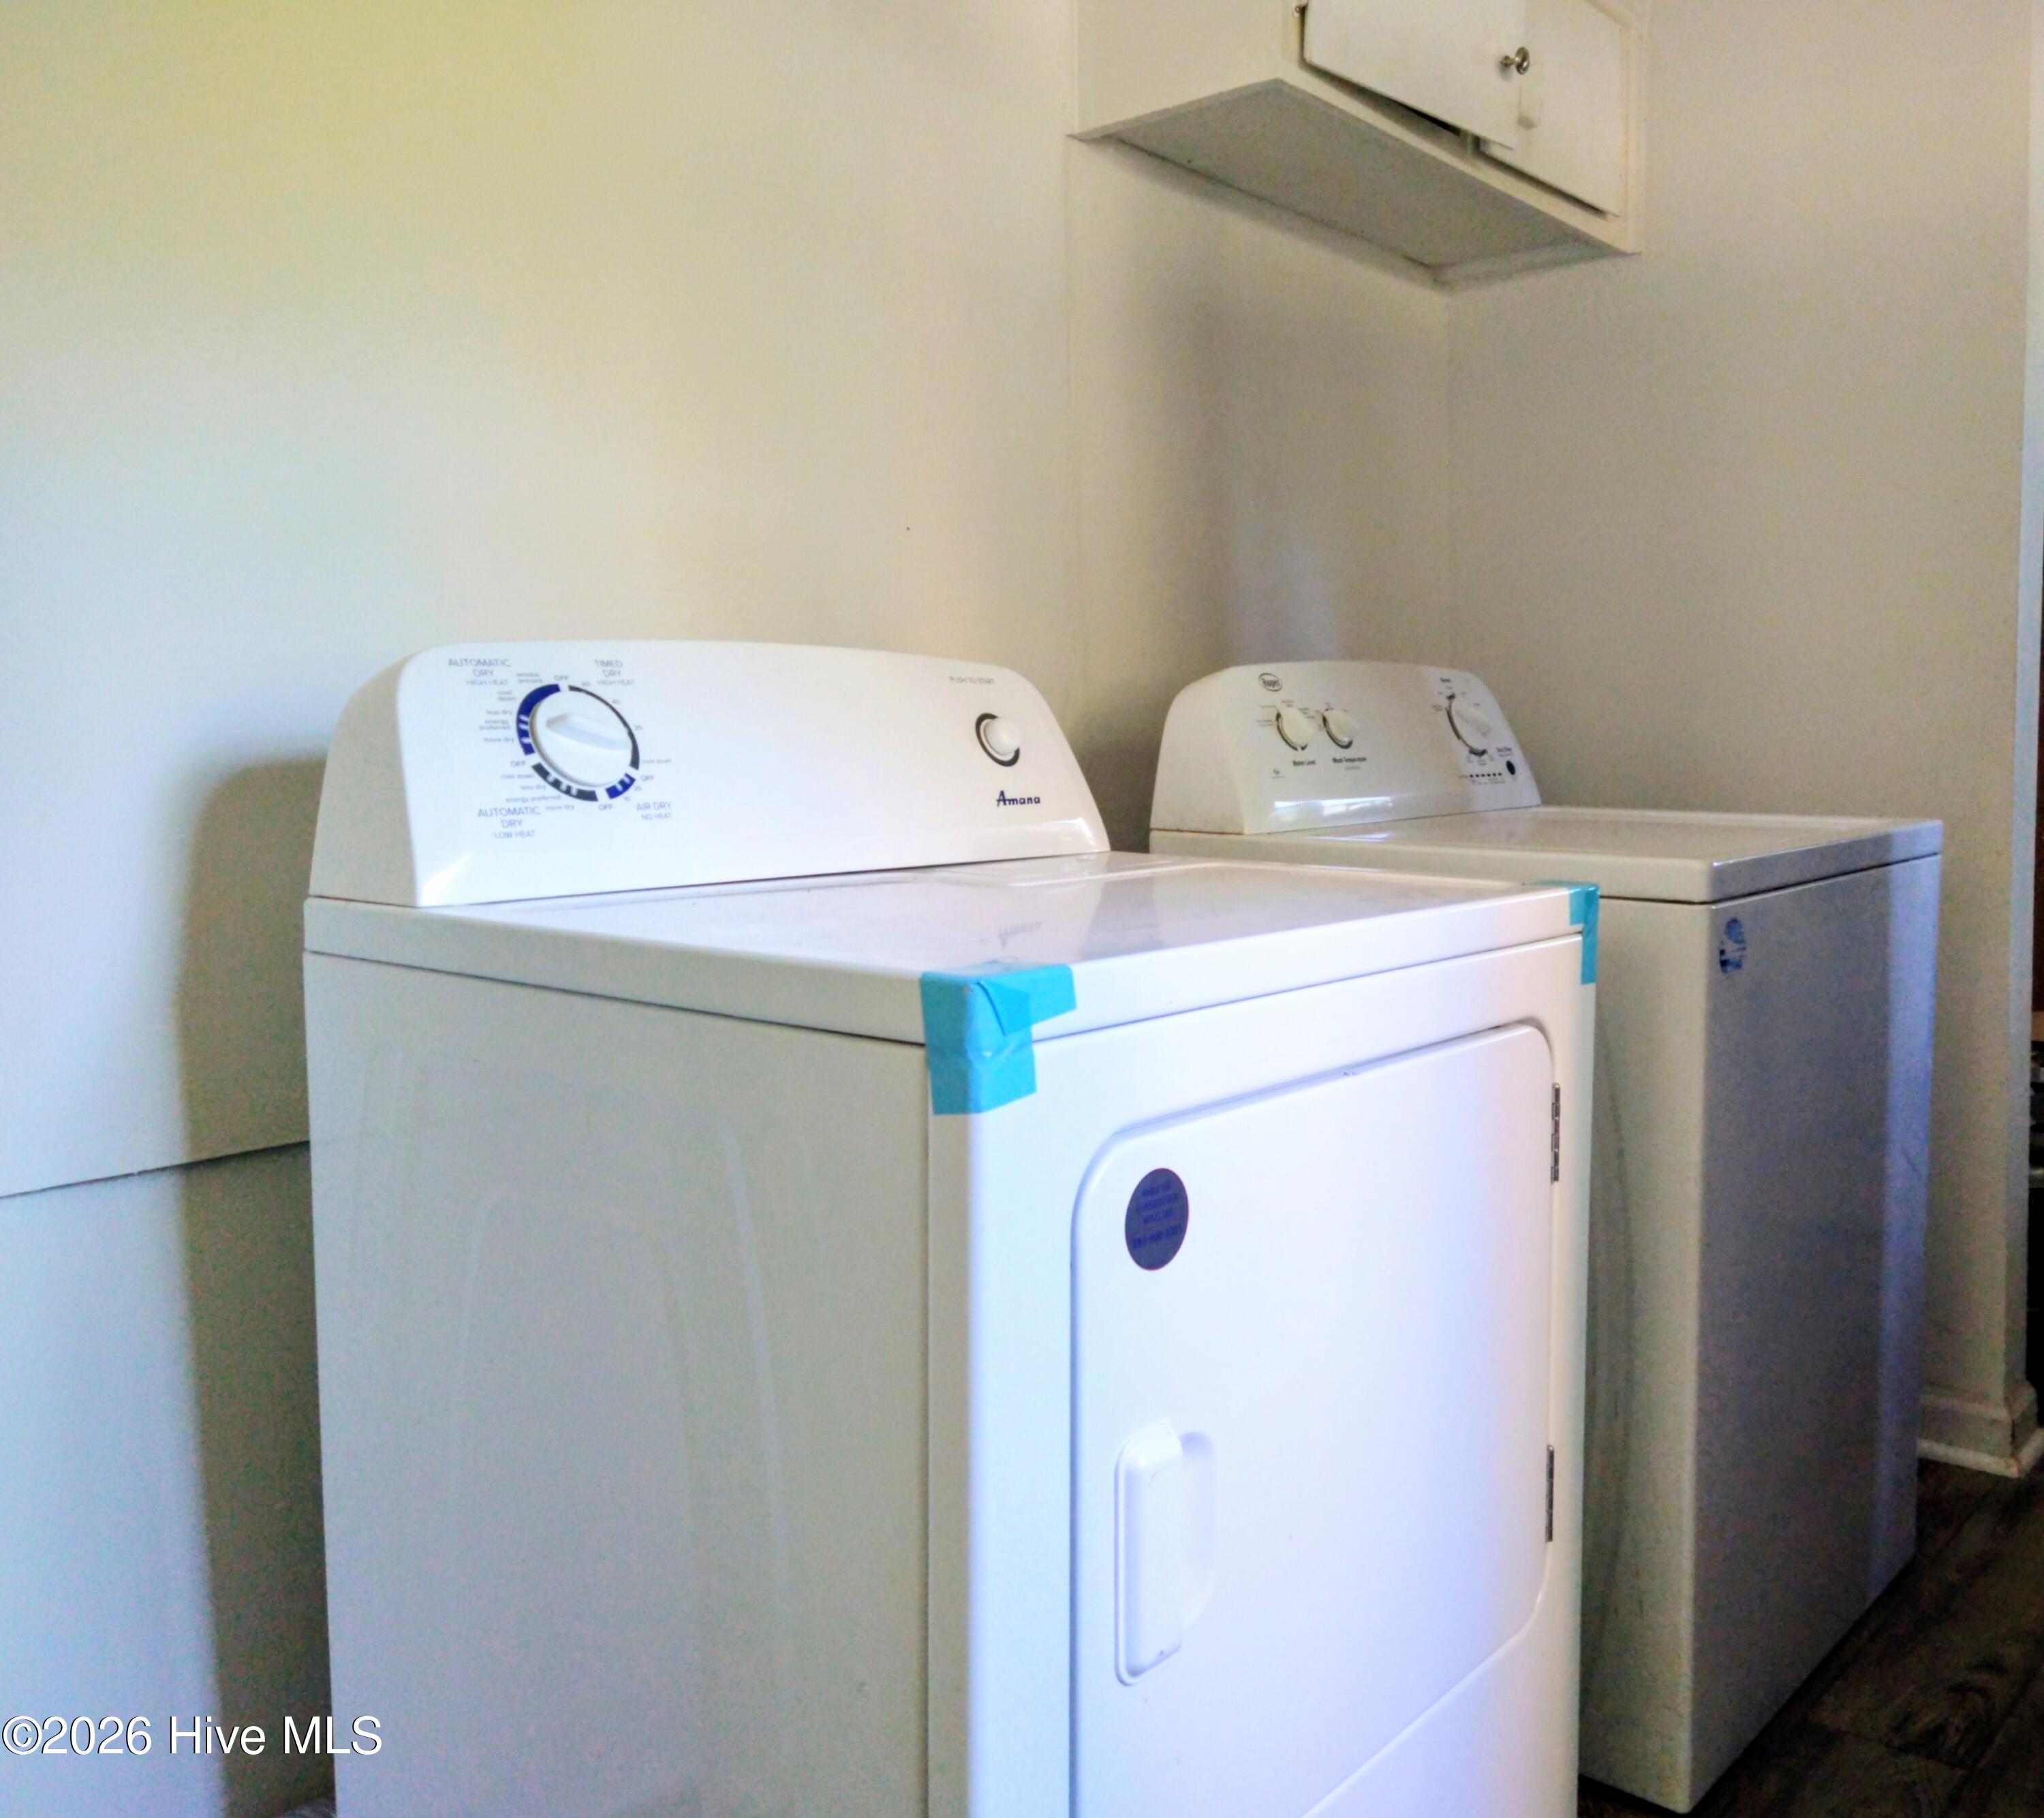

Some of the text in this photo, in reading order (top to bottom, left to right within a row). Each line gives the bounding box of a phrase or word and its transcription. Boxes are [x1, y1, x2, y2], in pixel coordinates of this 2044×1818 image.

[448, 659, 512, 668] AUTOMATIC
[594, 659, 623, 668] TIMED
[473, 669, 494, 677] DRY
[602, 670, 621, 678] DRY
[996, 789, 1041, 807] Amana
[636, 802, 671, 811] AIR DRY
[478, 806, 541, 817] AUTOMATIC
[501, 819, 523, 829] DRY
[495, 830, 536, 839] LOW HEAT
